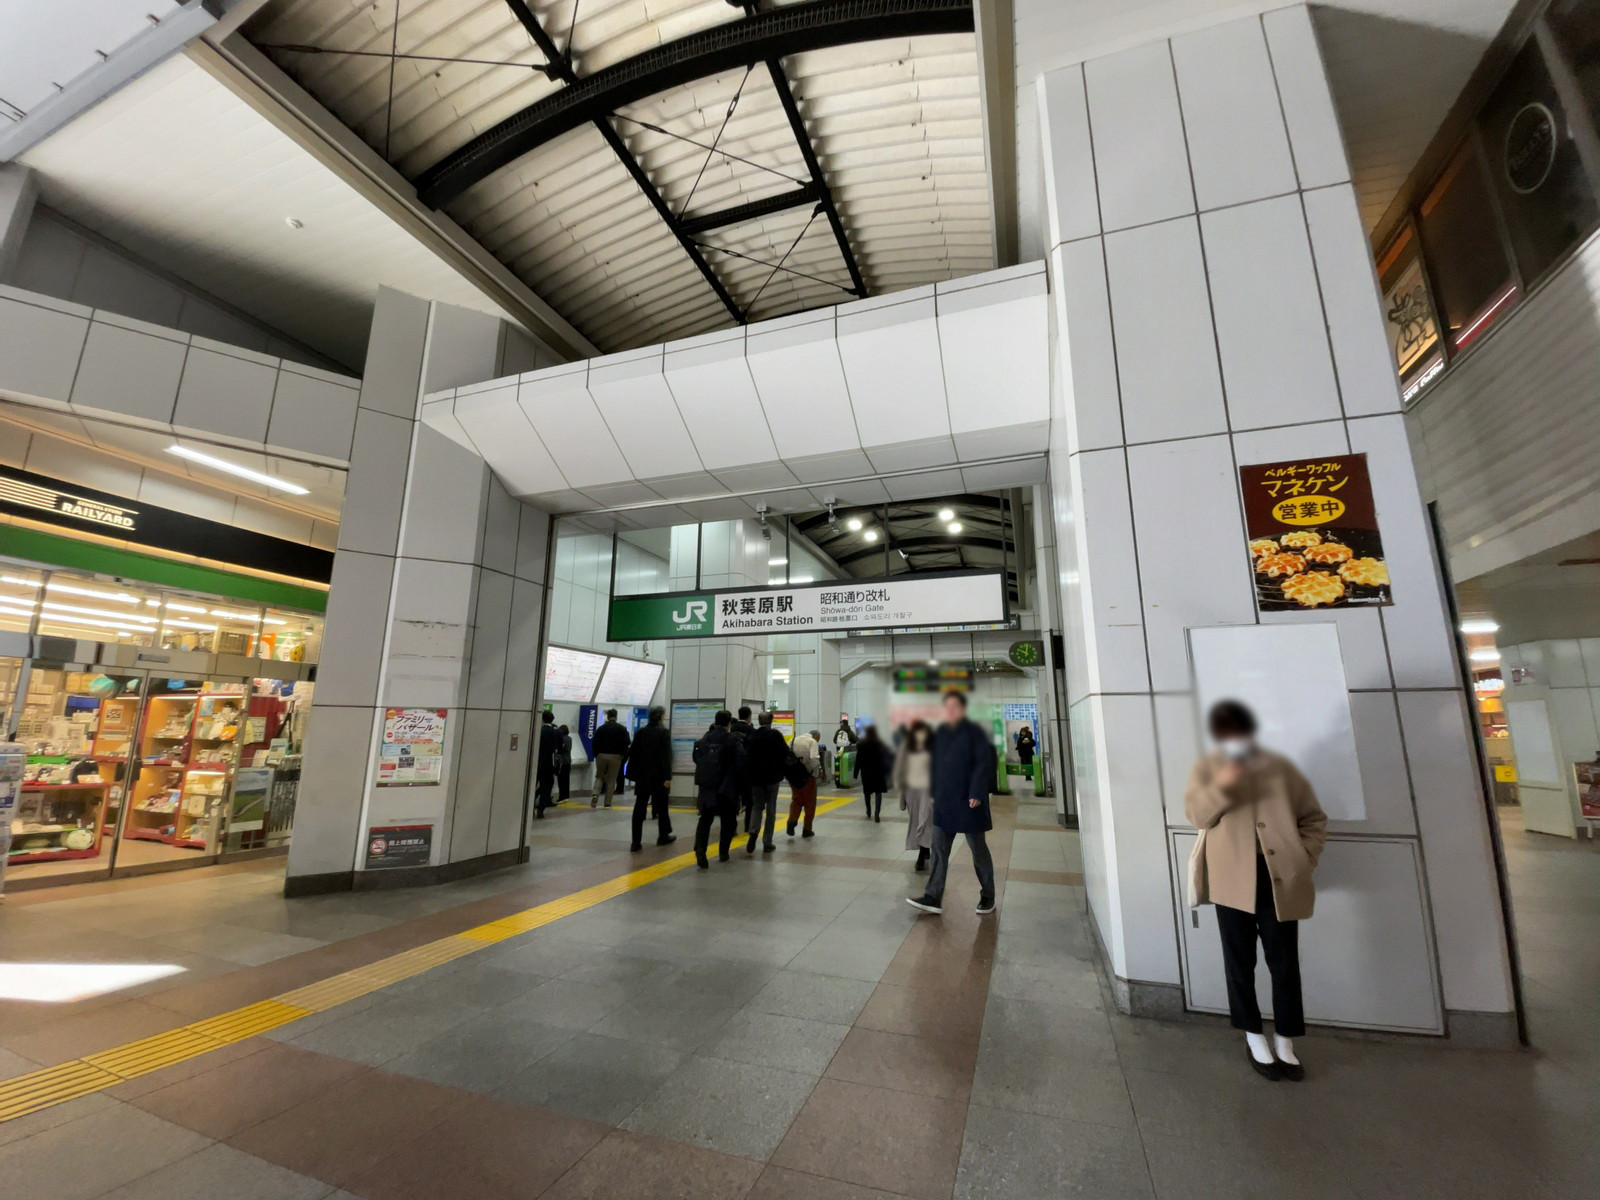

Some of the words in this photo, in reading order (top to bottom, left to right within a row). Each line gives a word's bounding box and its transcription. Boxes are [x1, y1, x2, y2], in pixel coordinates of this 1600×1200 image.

[1265, 463, 1341, 477] ベルギーワッフル
[1260, 475, 1349, 498] マネケン
[61, 502, 134, 527] RAILYARD
[1278, 500, 1340, 520] 営業中
[722, 595, 793, 616] 秋葉原駅
[820, 588, 890, 605] 昭和通り改札
[672, 600, 708, 623] JR
[865, 603, 884, 612] Gate
[676, 623, 702, 631] JR東日本
[722, 617, 773, 629] Akihabara
[776, 615, 813, 627] Station
[587, 709, 596, 739] MIZUHO
